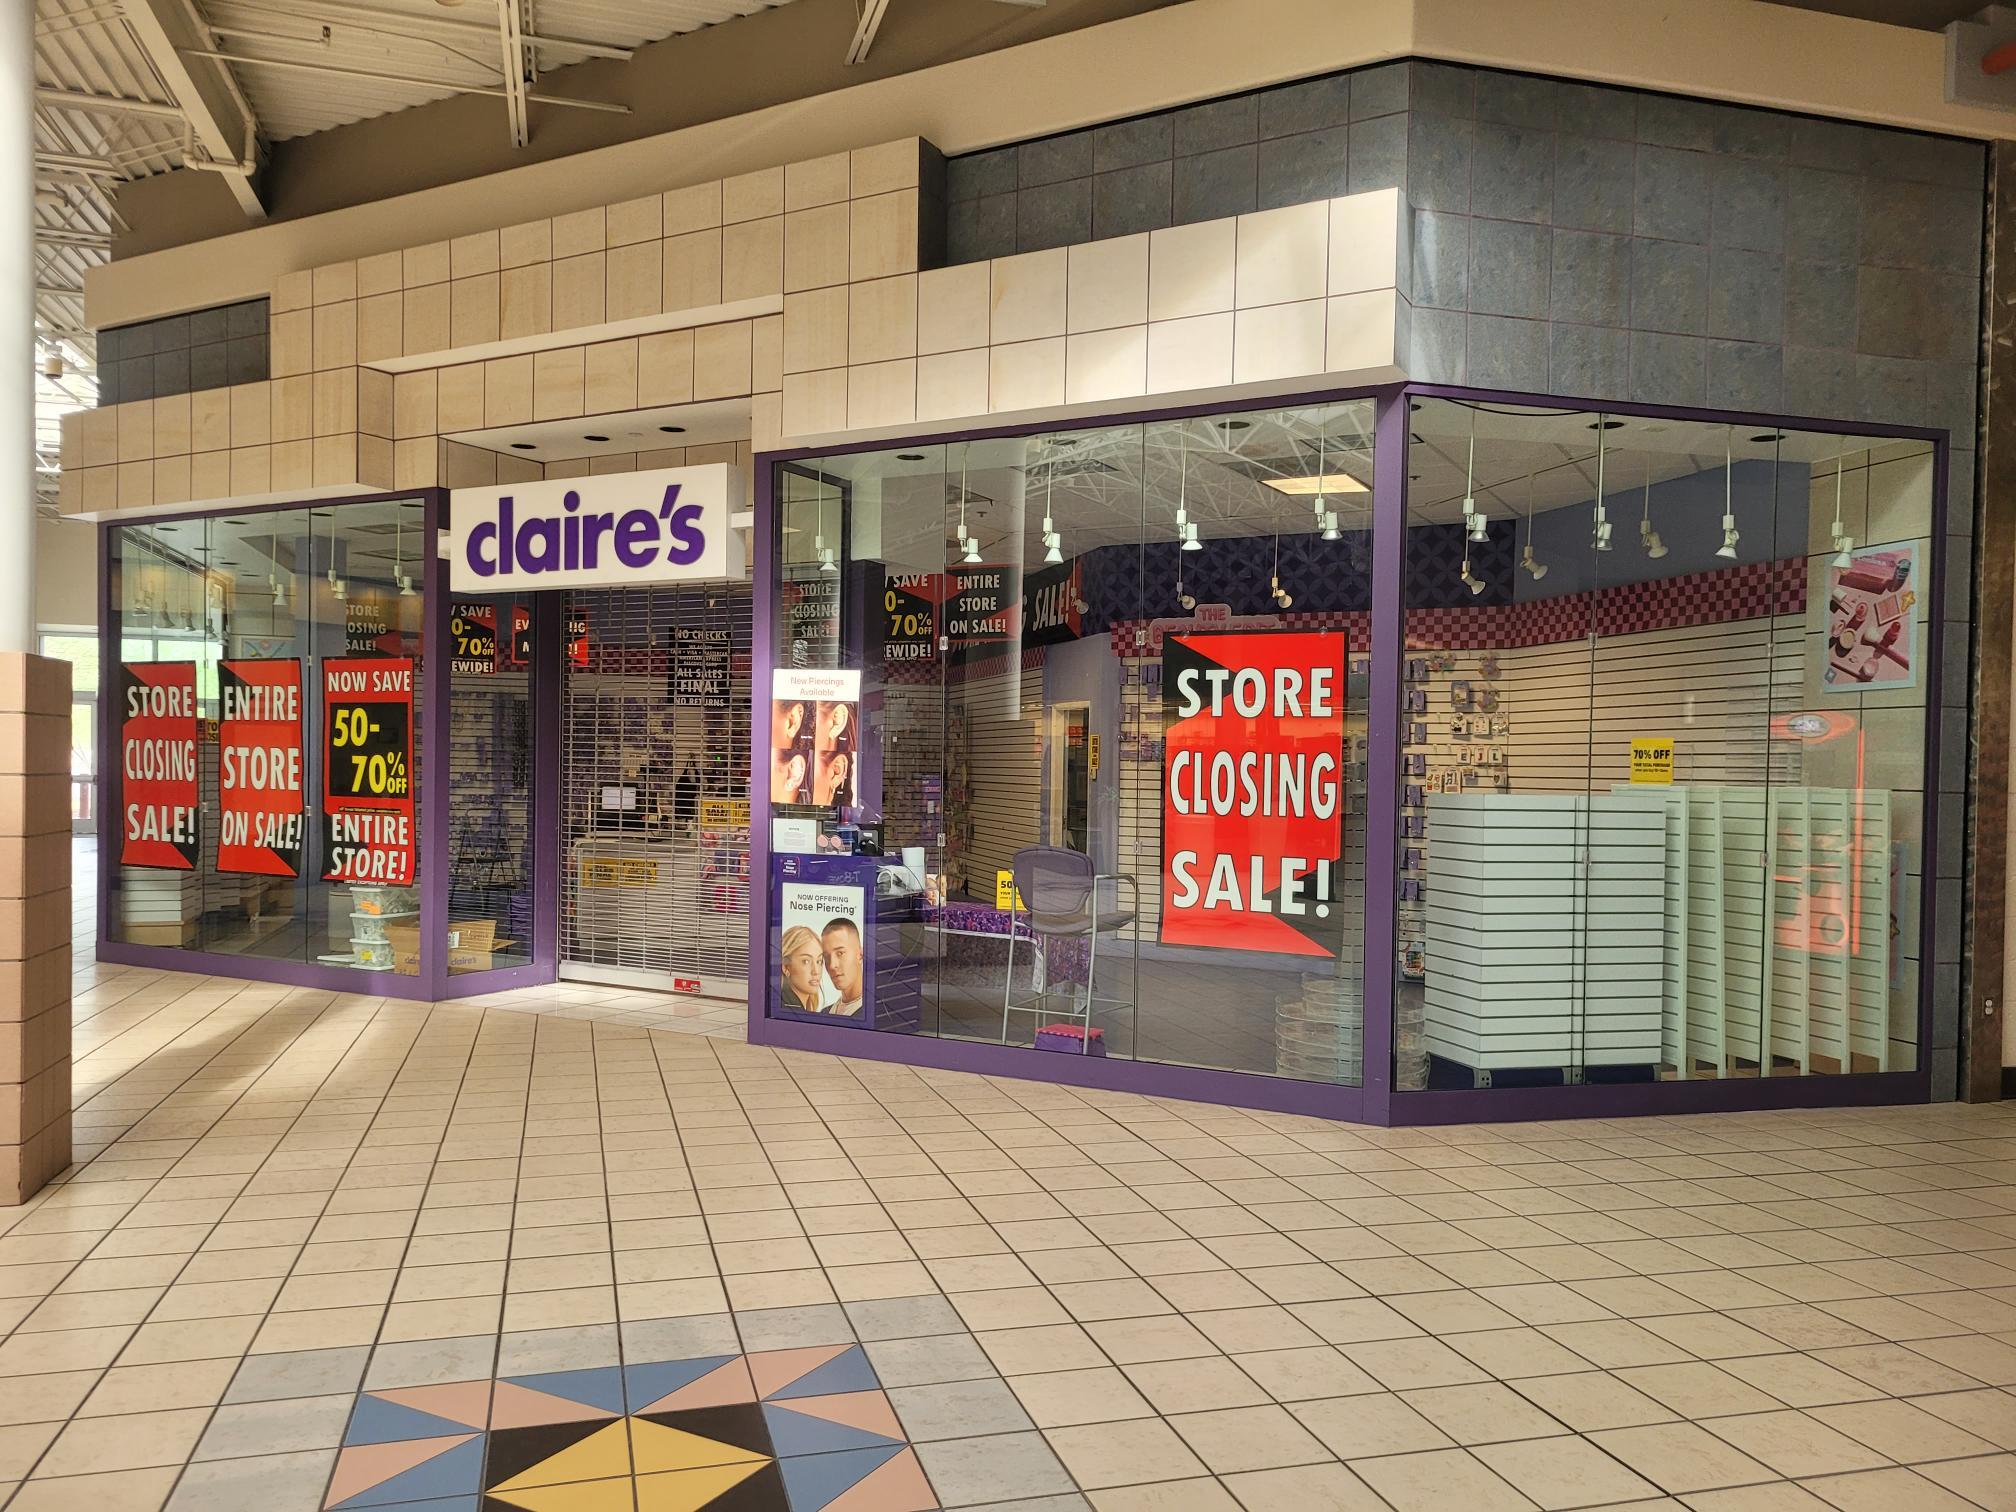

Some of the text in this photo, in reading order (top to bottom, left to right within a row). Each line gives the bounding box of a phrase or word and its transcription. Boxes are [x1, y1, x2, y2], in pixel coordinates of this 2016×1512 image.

[466, 484, 705, 577] claire's
[893, 574, 928, 588] SAVE
[957, 574, 1000, 590] ENTIRE
[884, 590, 905, 612] 0-
[959, 597, 997, 612] STORE
[1032, 579, 1071, 631] SALE!
[460, 605, 492, 618] SAVE
[793, 603, 839, 618] CLOSING
[1199, 607, 1226, 621] THE
[347, 622, 387, 635] OSING
[451, 618, 471, 636] 0-
[891, 612, 933, 636] 70% OFF
[949, 618, 1007, 634] ON SALE!
[692, 630, 727, 640] CHECKS
[458, 637, 495, 656] 70% OFF
[884, 643, 932, 658] EWIDE!
[451, 660, 494, 673] EWIDE!
[677, 667, 693, 678] ALL
[327, 670, 411, 692] NOW SAVE
[680, 681, 720, 693] FINAL
[790, 676, 845, 687] New Piercings
[799, 687, 835, 696] Available
[1176, 667, 1334, 718] STORE
[127, 685, 193, 718] STORE
[223, 685, 298, 721] ENTIRE
[333, 707, 380, 748] 50-
[124, 739, 196, 782] CLOSING
[1633, 749, 1671, 760] 70% OFF
[223, 746, 300, 791] STORE
[351, 752, 408, 795] 70% OFF
[1170, 750, 1337, 820] CLOSING
[127, 803, 196, 845] SALE!
[221, 810, 303, 850] ON SALE!
[332, 813, 409, 846] ENTIRE
[330, 846, 407, 881] STORE!
[1170, 850, 1331, 919] SALE!
[789, 900, 855, 916] Nose Piercing
[797, 894, 849, 904] NOW OFFERING
